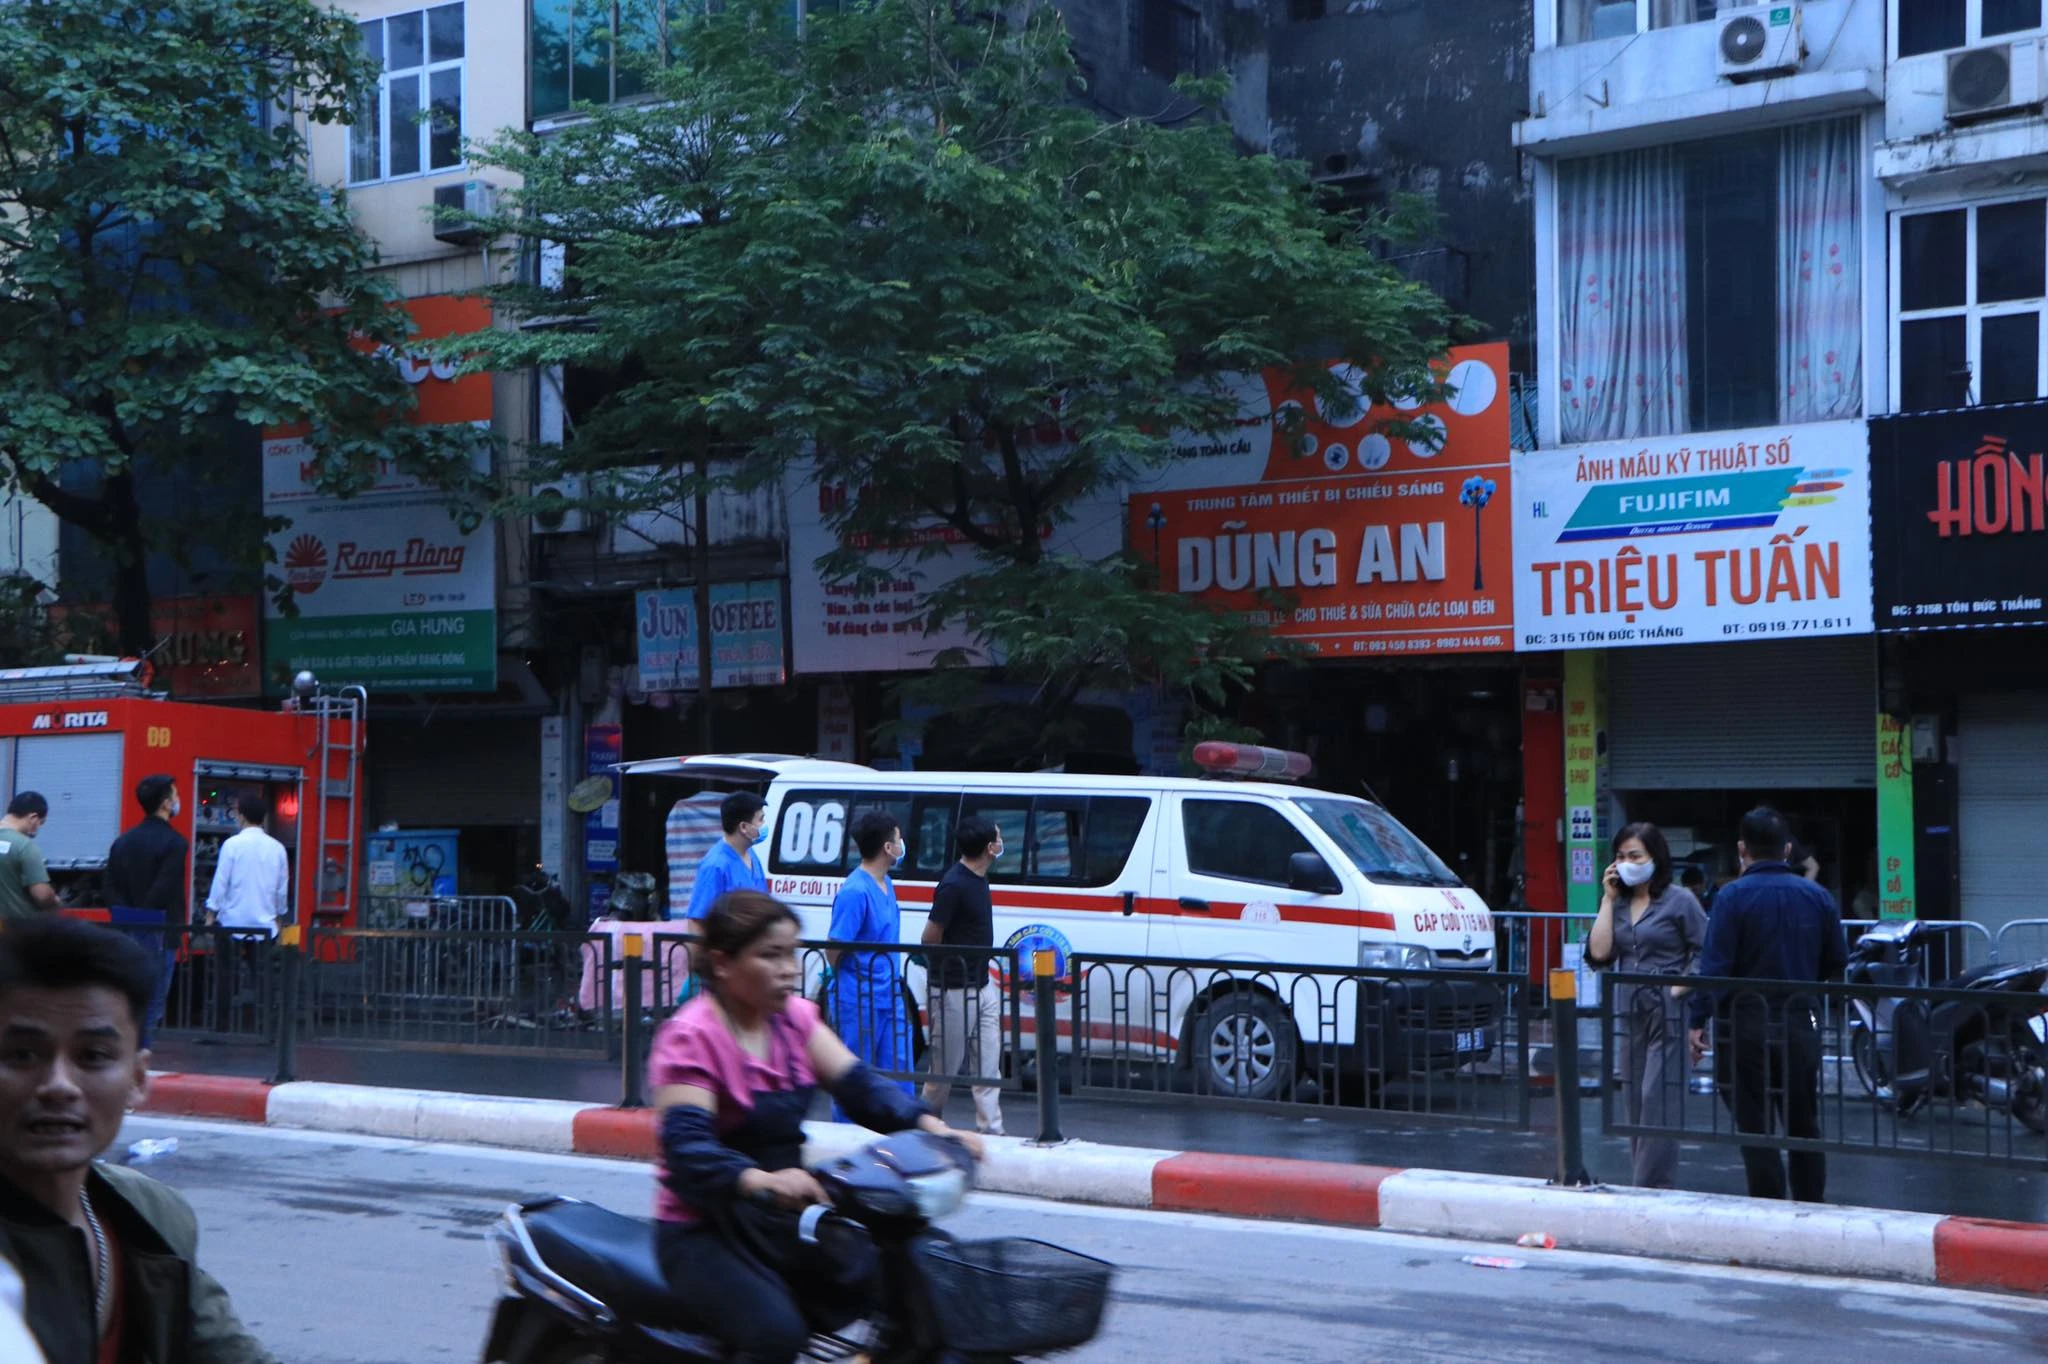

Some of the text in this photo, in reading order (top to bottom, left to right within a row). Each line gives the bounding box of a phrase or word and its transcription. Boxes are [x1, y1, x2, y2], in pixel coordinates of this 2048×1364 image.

[1230, 437, 1251, 454] CẦU
[1577, 455, 1614, 482] ẢNH
[1667, 448, 1692, 475] KỸ
[1696, 442, 1759, 473] THUẬT
[1766, 435, 1793, 466] SỐ
[1187, 497, 1236, 512] TRUNG
[1240, 493, 1272, 509] TÂM
[1278, 485, 1319, 505] THIẾT
[1325, 488, 1340, 504] BỊ
[1398, 480, 1444, 496] SÁNG
[1927, 434, 2048, 537] HỒN
[1533, 501, 1549, 518] HL
[1619, 487, 1731, 514] FUJIFIM
[1177, 520, 1447, 593] DŨNG AN
[1531, 525, 1840, 624] TRIỆU TUẤN
[711, 600, 776, 633] OFFEE
[1295, 607, 1317, 623] CHO
[1350, 607, 1358, 619] &
[1386, 601, 1415, 619] CHỮA
[1418, 599, 1441, 617] CÁC
[1444, 600, 1468, 619] LOẠI
[1472, 597, 1495, 615] ĐÈN
[1892, 605, 1912, 617] ĐC:
[1945, 600, 1969, 613] TÔN
[1973, 599, 1997, 613] ĐỨC
[392, 618, 417, 637] GIA
[420, 616, 465, 636] HƯNG
[1525, 617, 1853, 645] ĐC: 315 TÔN ĐỨC THẮNG ĐT: 0919.771.611
[32, 711, 109, 730] MORITA
[780, 801, 845, 864] 06
[775, 877, 797, 895] CẤP
[800, 878, 821, 896] CỨU
[1414, 909, 1438, 932] CẤP
